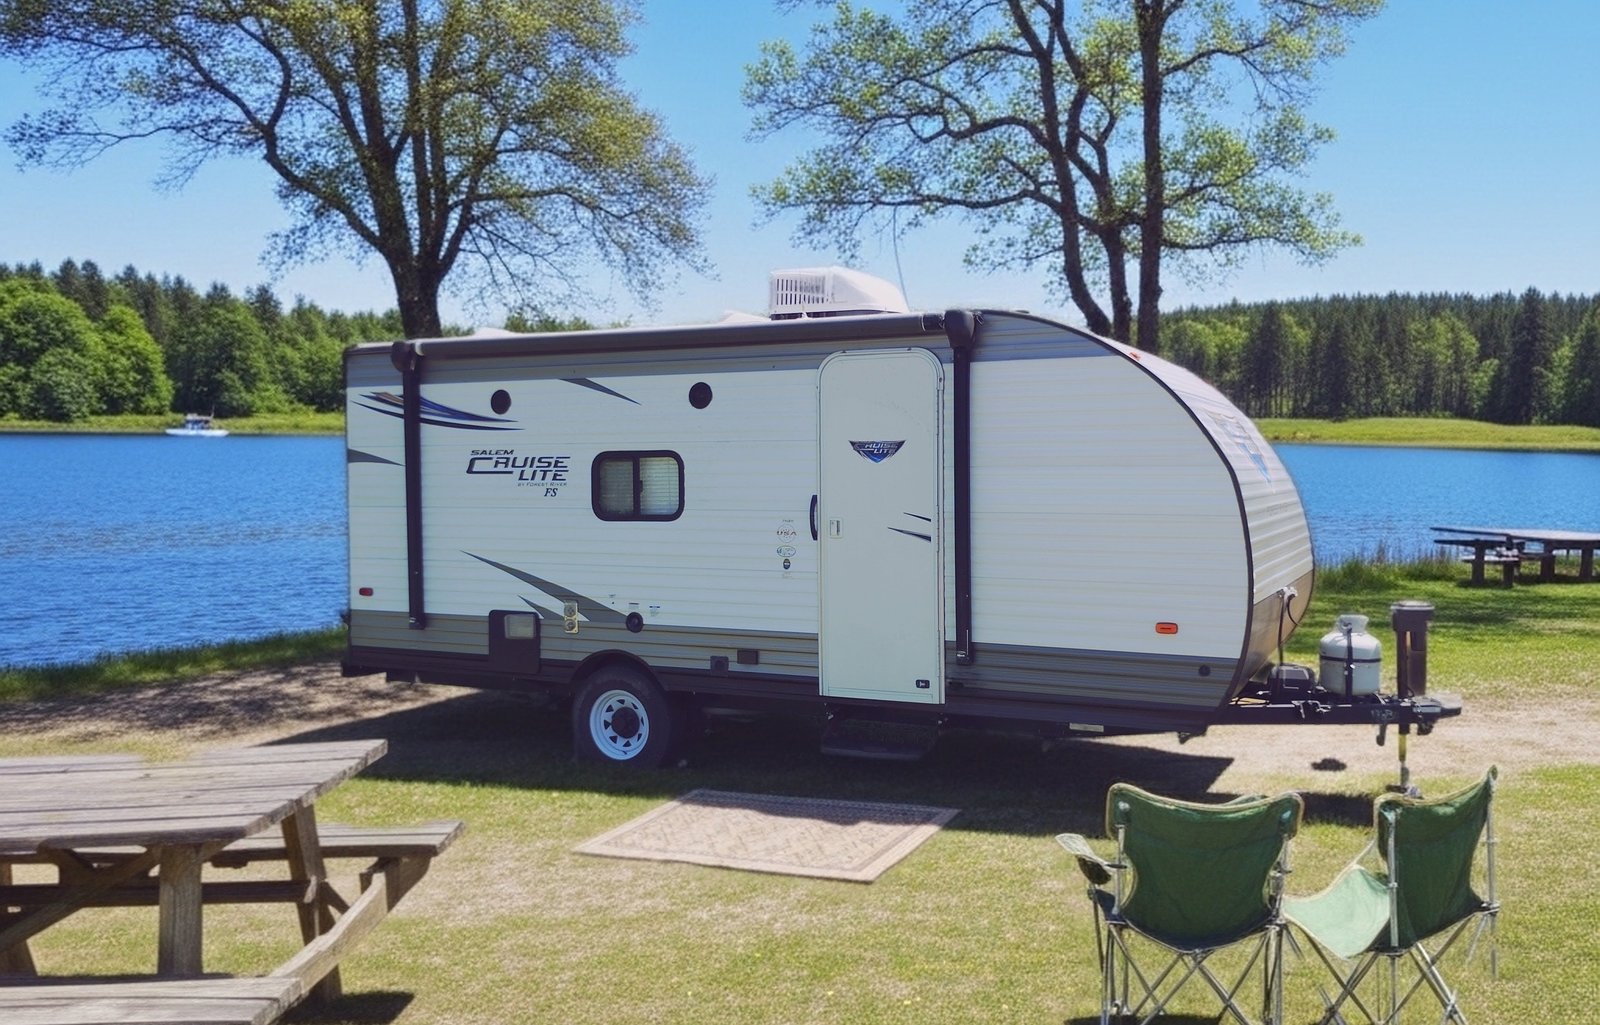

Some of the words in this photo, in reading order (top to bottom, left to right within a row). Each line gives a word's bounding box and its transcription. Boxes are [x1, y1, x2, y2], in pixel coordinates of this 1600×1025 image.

[466, 456, 571, 474] CRUISE
[518, 469, 569, 481] LITE
[544, 487, 558, 497] FS
